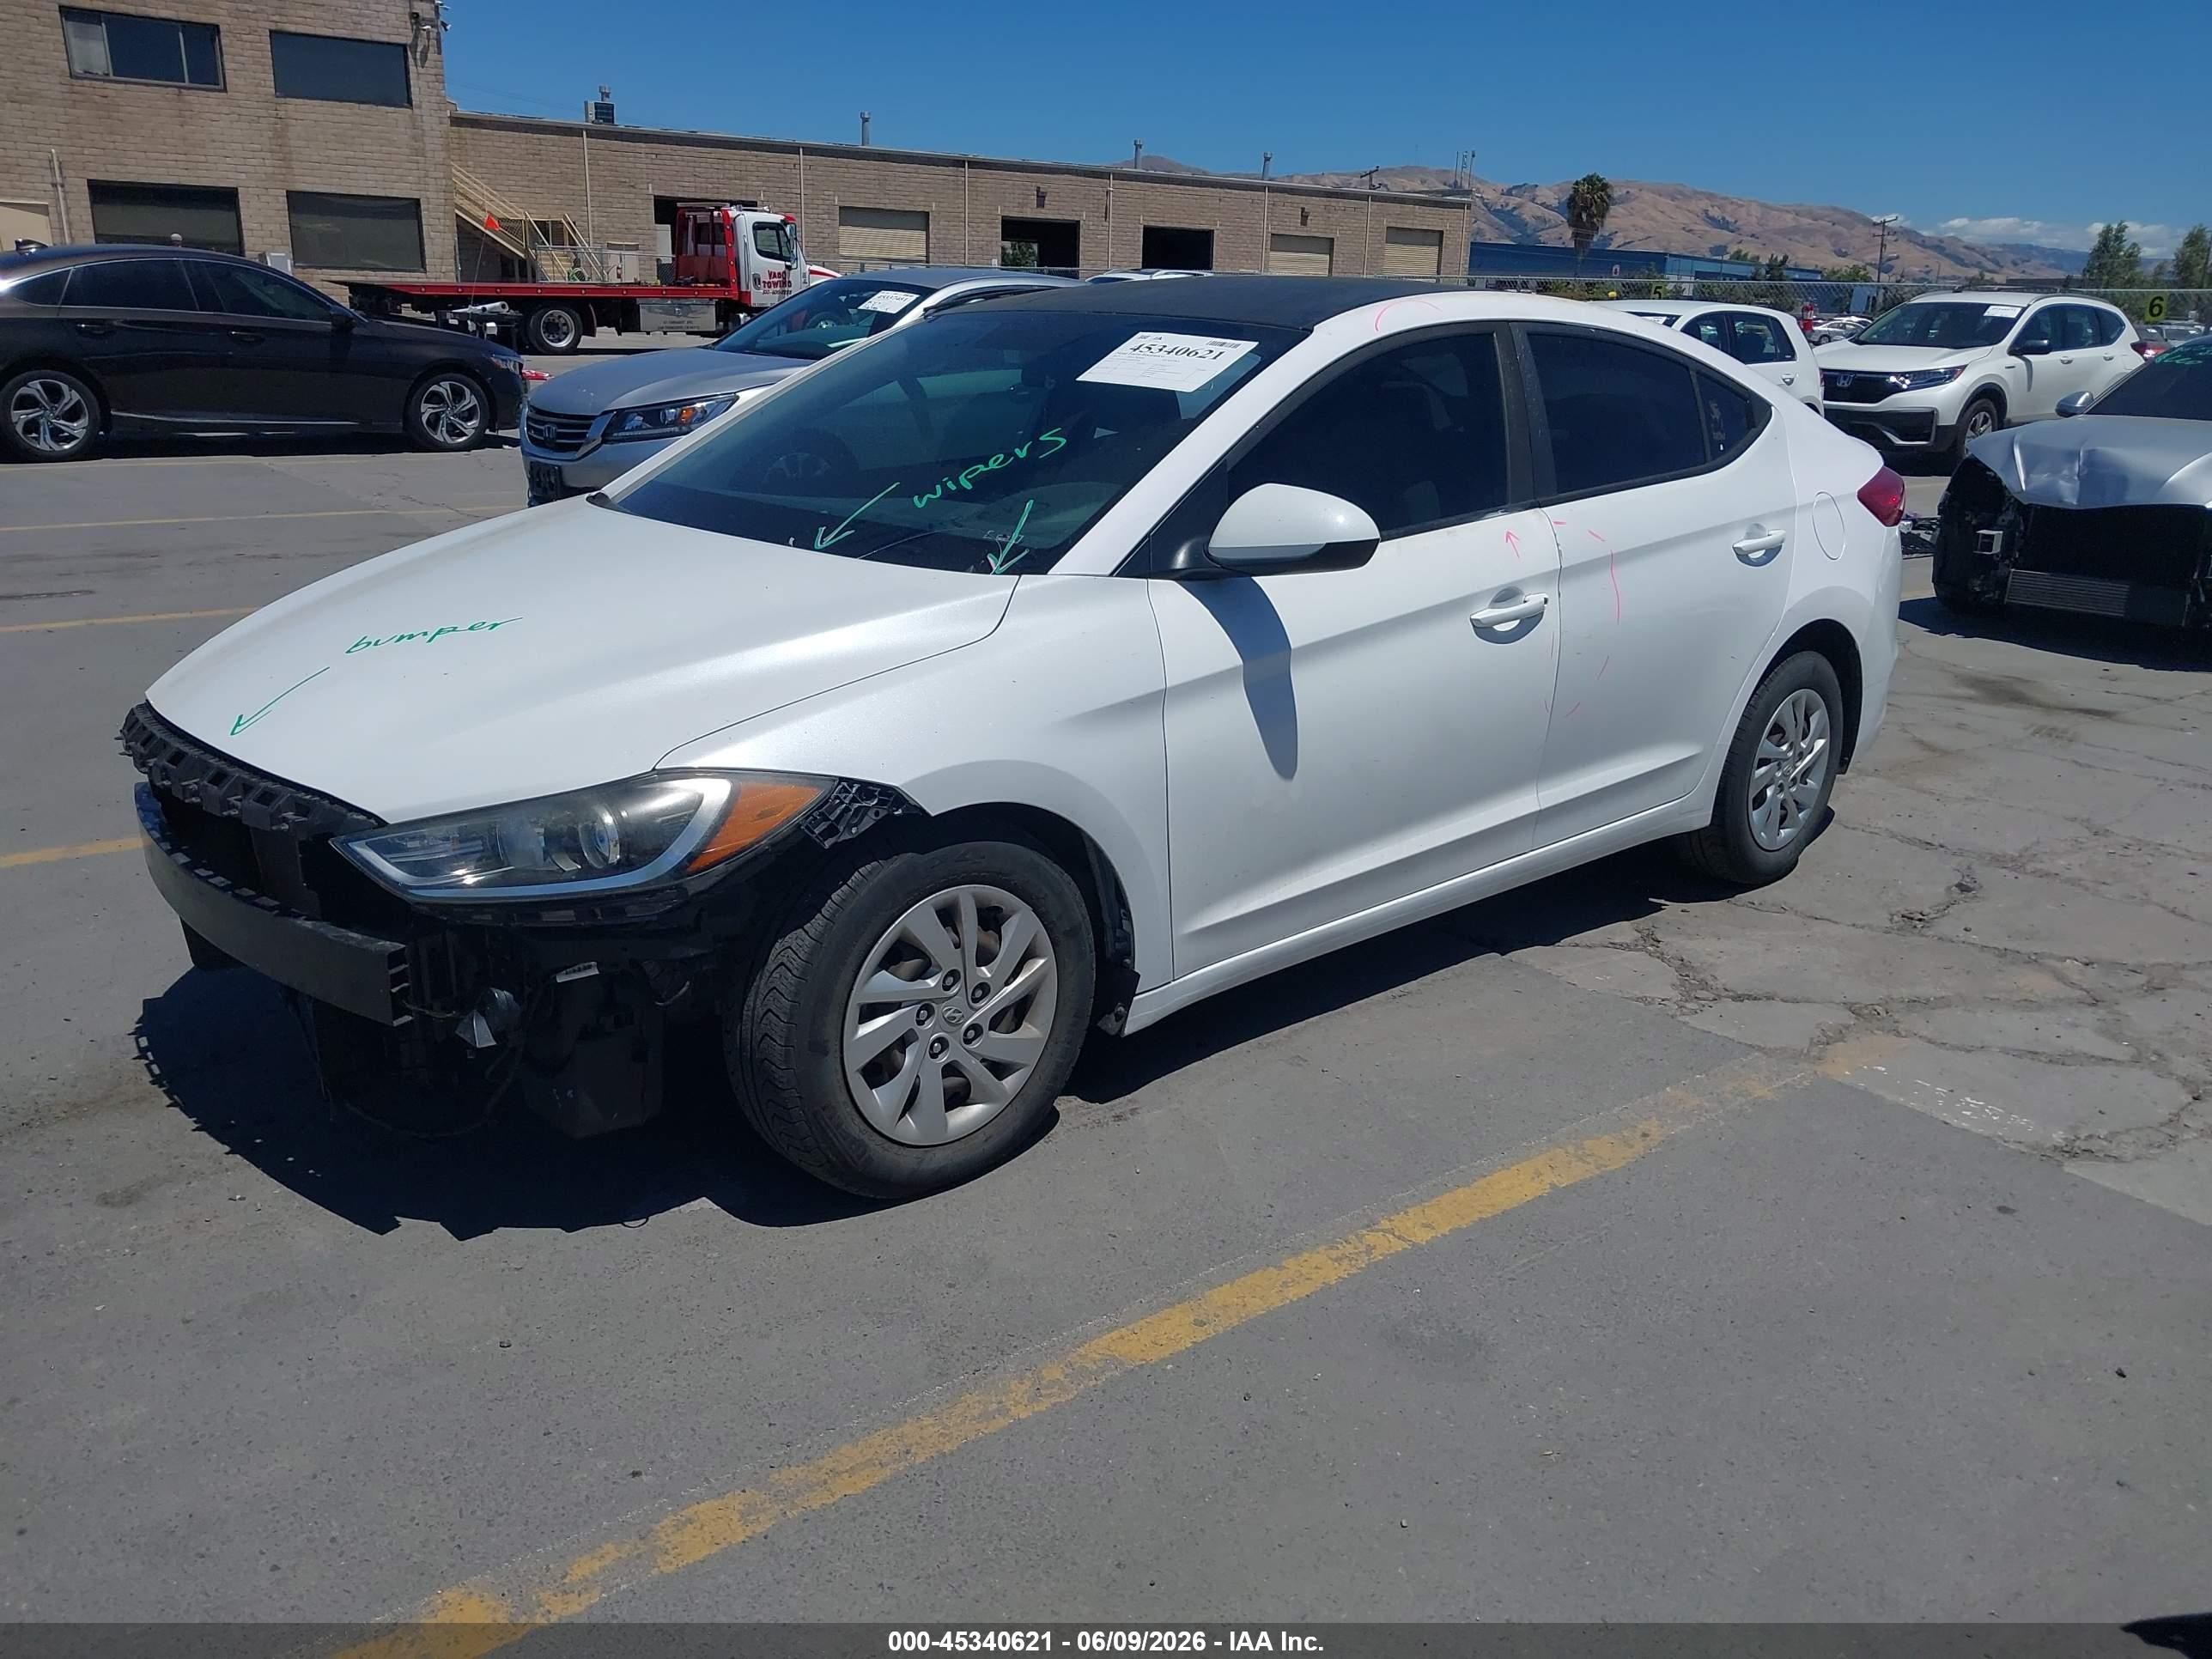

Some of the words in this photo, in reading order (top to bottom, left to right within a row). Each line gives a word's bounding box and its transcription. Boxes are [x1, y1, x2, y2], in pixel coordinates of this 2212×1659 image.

[1653, 285, 1663, 300] 5
[2148, 295, 2164, 318] 6
[1129, 343, 1226, 361] 45340621
[913, 428, 1067, 508] wipers
[344, 617, 524, 654] bumper
